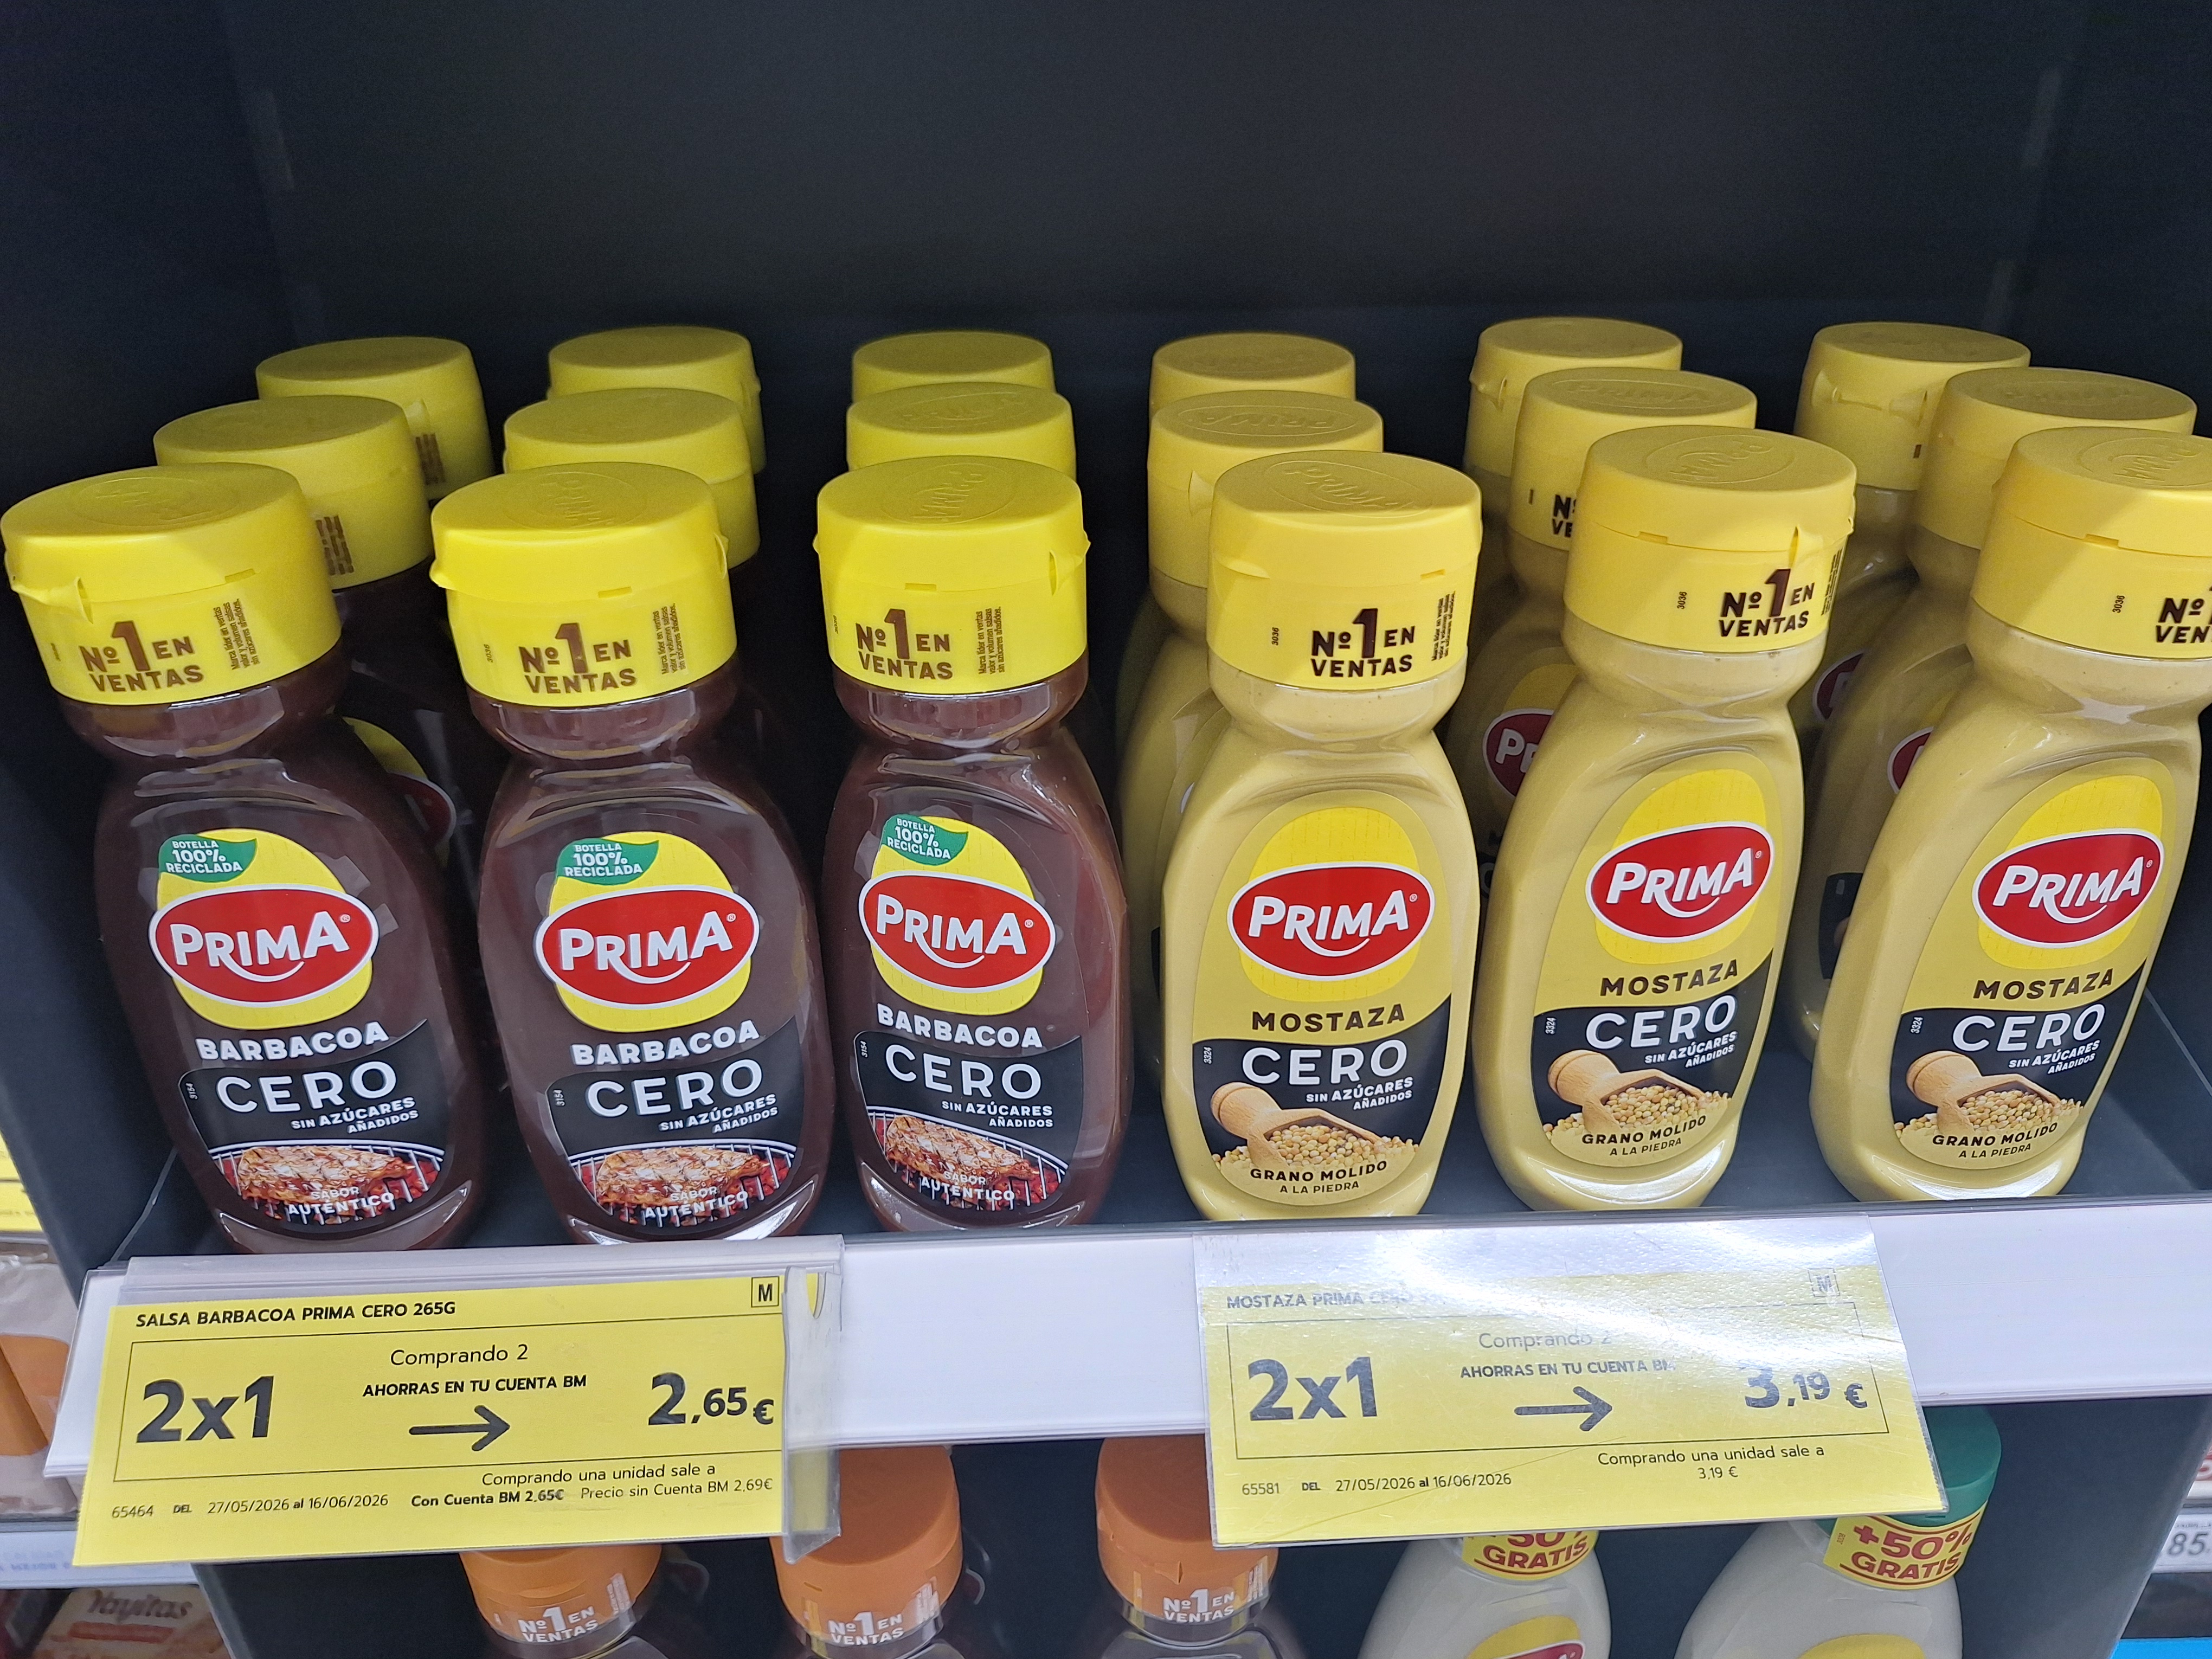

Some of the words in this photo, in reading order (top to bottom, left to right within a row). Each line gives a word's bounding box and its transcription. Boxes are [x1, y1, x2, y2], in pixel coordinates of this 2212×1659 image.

[1677, 591, 1687, 609] 3036
[1721, 591, 1762, 617] Nº
[1765, 568, 1791, 617] 1
[1790, 583, 1815, 606] EN
[2112, 595, 2125, 613] 3036
[2158, 597, 2204, 623] Nº
[856, 622, 886, 652] Nº
[884, 608, 910, 659] 1
[916, 634, 950, 652] EN
[1271, 627, 1279, 646] 3036
[1311, 630, 1351, 657] Nº
[1352, 608, 1378, 658] 1
[1384, 626, 1415, 647] EN
[1718, 610, 1809, 637] VENTAS
[2156, 625, 2212, 644] VEN
[79, 646, 120, 672] Nº
[111, 620, 150, 671] 1
[152, 636, 195, 659] EN
[518, 646, 560, 673] Nº
[555, 622, 588, 673] 1
[593, 640, 632, 662] EN
[859, 651, 953, 679] VENTAS
[1310, 654, 1413, 677] VENTAS
[90, 665, 203, 692] VENTAS
[524, 668, 636, 693] VENTAS
[895, 826, 938, 848] 100%
[897, 818, 935, 834] BOTELLA
[887, 836, 951, 859] RECICLADA
[1606, 847, 1752, 918] PRIMA
[1992, 856, 2144, 924] PRIMA
[877, 893, 1027, 969] PRIMA
[1248, 890, 1409, 957] PRIMA
[170, 911, 350, 982] PRIMA
[559, 911, 733, 984] PRIMA
[1600, 959, 1738, 996] MOSTAZA
[1973, 968, 2113, 999] MOSTAZA
[877, 1003, 1043, 1048] BARBACOA
[1252, 1004, 1405, 1032] MOSTAZA
[1586, 995, 1737, 1049] CERO
[1911, 1017, 1923, 1034] 3324
[1952, 1004, 2106, 1052] CERO
[195, 1021, 389, 1061] BARBACOA
[571, 1020, 760, 1065] BARBACOA
[1645, 1053, 1665, 1064] SIN
[1668, 1031, 1737, 1061] AZÚCARES
[1203, 1046, 1212, 1064] 3324
[1242, 1039, 1407, 1085] CERO
[1685, 1044, 1735, 1068] AÑADIDOS
[885, 1044, 1041, 1099] CERO
[217, 1061, 396, 1113] CERO
[585, 1059, 764, 1117] CERO
[1306, 1093, 1328, 1102] SIN
[1331, 1077, 1413, 1102] AZÚCARES
[1353, 1090, 1413, 1110] AÑADIDOS
[659, 1120, 683, 1131] SIN
[686, 1094, 776, 1127] AZÚCARES
[712, 1108, 777, 1133] AÑADIDOS
[942, 1101, 962, 1113] SIN
[966, 1101, 1053, 1117] AZÚCARES
[989, 1115, 1053, 1128] AÑADIDOS
[943, 1171, 986, 1186] SABOR
[1250, 1168, 1314, 1182] GRANO
[1320, 1160, 1387, 1180] MOLIDO
[922, 1178, 1015, 1201] AUTÉNTICO
[1280, 1185, 1288, 1193] A
[1293, 1185, 1308, 1194] LA
[1313, 1181, 1360, 1193] PIEDRA
[758, 1283, 773, 1302] M
[1227, 1294, 1308, 1309] MOSTAZA
[1313, 1292, 1362, 1306] PRIMA
[136, 1312, 190, 1327] SALSA
[197, 1308, 295, 1326] BARBACOA
[302, 1306, 355, 1321] PRIMA
[362, 1303, 408, 1319] CERO
[413, 1301, 456, 1316] 265G
[1478, 1332, 1593, 1351] Comprando
[390, 1345, 508, 1369] Comprando
[517, 1343, 529, 1360] 2
[1461, 1364, 1534, 1379] AHORRAS
[1539, 1364, 1558, 1375] EN
[1562, 1362, 1583, 1375] TU
[1587, 1360, 1648, 1374] CUENTA
[362, 1381, 440, 1397] AHORRAS
[445, 1381, 465, 1393] EN
[471, 1380, 490, 1392] TU
[495, 1376, 557, 1391] CUENTA
[563, 1374, 587, 1388] BM
[1248, 1356, 1377, 1421] 2x1
[1843, 1383, 1867, 1409] €
[136, 1375, 274, 1444] 2x1
[1598, 1450, 1686, 1467] Comprando
[1692, 1450, 1719, 1462] una
[1724, 1446, 1774, 1460] unidad
[1780, 1444, 1810, 1458] sale
[1816, 1446, 1824, 1456] a
[482, 1468, 573, 1488] Comprando
[578, 1470, 606, 1481] una
[612, 1464, 666, 1480] unidad
[671, 1463, 701, 1477] sale
[706, 1464, 716, 1475] a
[1242, 1483, 1280, 1495] 65581
[1302, 1482, 1320, 1491] DEL
[1335, 1477, 1415, 1491] 27/05/2026
[1419, 1477, 1429, 1488] al
[1433, 1474, 1512, 1488] 16/06/2026
[1728, 1467, 1739, 1477] €
[112, 1505, 153, 1519] 65464
[173, 1504, 192, 1515] DEL
[207, 1499, 290, 1514] 27/05/2026
[293, 1499, 304, 1509] al
[308, 1494, 389, 1510] 16/06/2026
[411, 1496, 439, 1507] Con
[443, 1493, 494, 1506] Cuenta
[499, 1491, 521, 1503] BM
[581, 1487, 624, 1500] Precio
[629, 1486, 648, 1497] sin
[654, 1482, 702, 1496] Cuenta
[707, 1481, 729, 1493] BM
[1483, 1535, 1587, 1569] GRATIS
[1854, 1523, 1972, 1560] +50%
[1851, 1552, 1961, 1579] GRATIS
[1163, 1597, 1191, 1612] Nº
[1190, 1588, 1208, 1613] 1
[1212, 1592, 1235, 1607] EN
[518, 1619, 548, 1633] Nº
[543, 1606, 567, 1631] 1
[568, 1606, 595, 1624] EN
[1163, 1605, 1234, 1623] VENTAS
[522, 1620, 598, 1643] VENTAS
